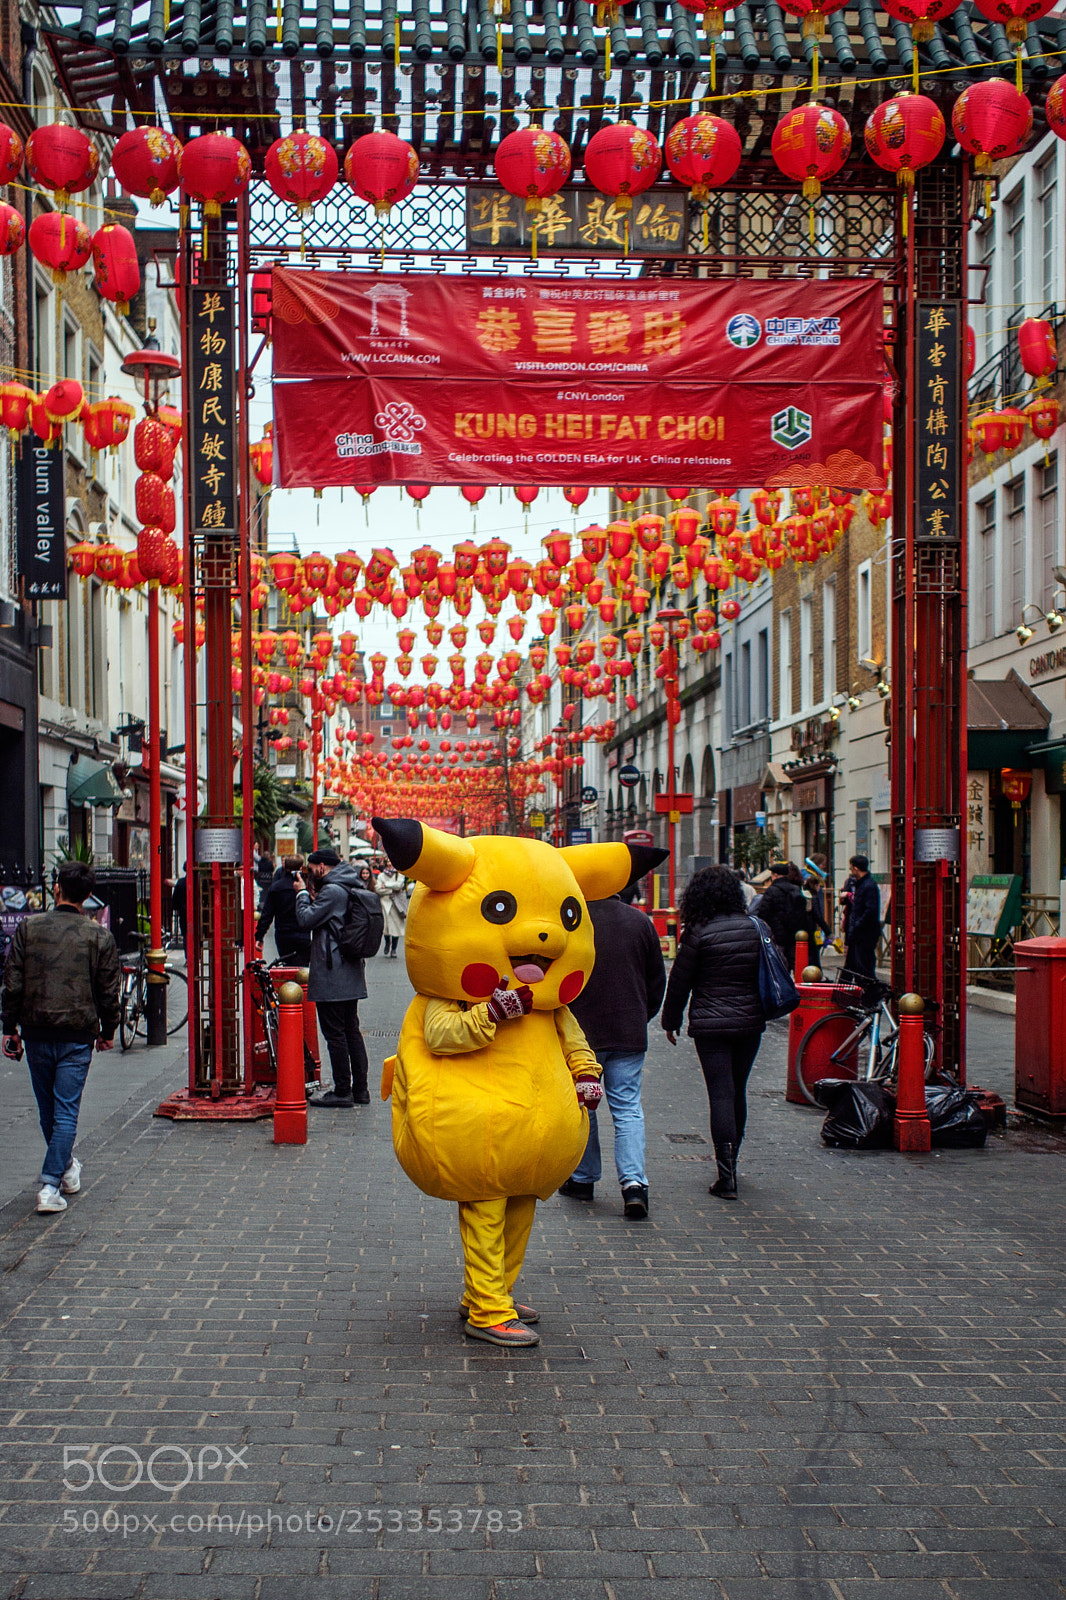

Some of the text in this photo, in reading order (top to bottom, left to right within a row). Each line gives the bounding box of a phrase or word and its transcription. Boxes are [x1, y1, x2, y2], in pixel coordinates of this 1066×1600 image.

[475, 305, 687, 356] 恭喜發財
[765, 316, 841, 334] 中国太平
[766, 335, 841, 345] CHINA TAIPING
[340, 351, 441, 365] WWW.LCCAUK.COM
[514, 361, 649, 373] VISITLONDON.COM/CHINA
[556, 391, 625, 402] #CNYLondon
[454, 412, 726, 441] KUNG HEI FAT CHOI
[335, 432, 374, 446] China
[338, 442, 382, 457] unicom
[448, 452, 513, 464] Celebrating
[515, 454, 534, 462] the
[535, 454, 582, 463] GOLDEN
[583, 455, 605, 463] ERA
[607, 454, 624, 463] for
[626, 455, 642, 464] UK
[651, 454, 681, 465] China
[683, 455, 732, 466] relations
[32, 447, 55, 563] plum valley
